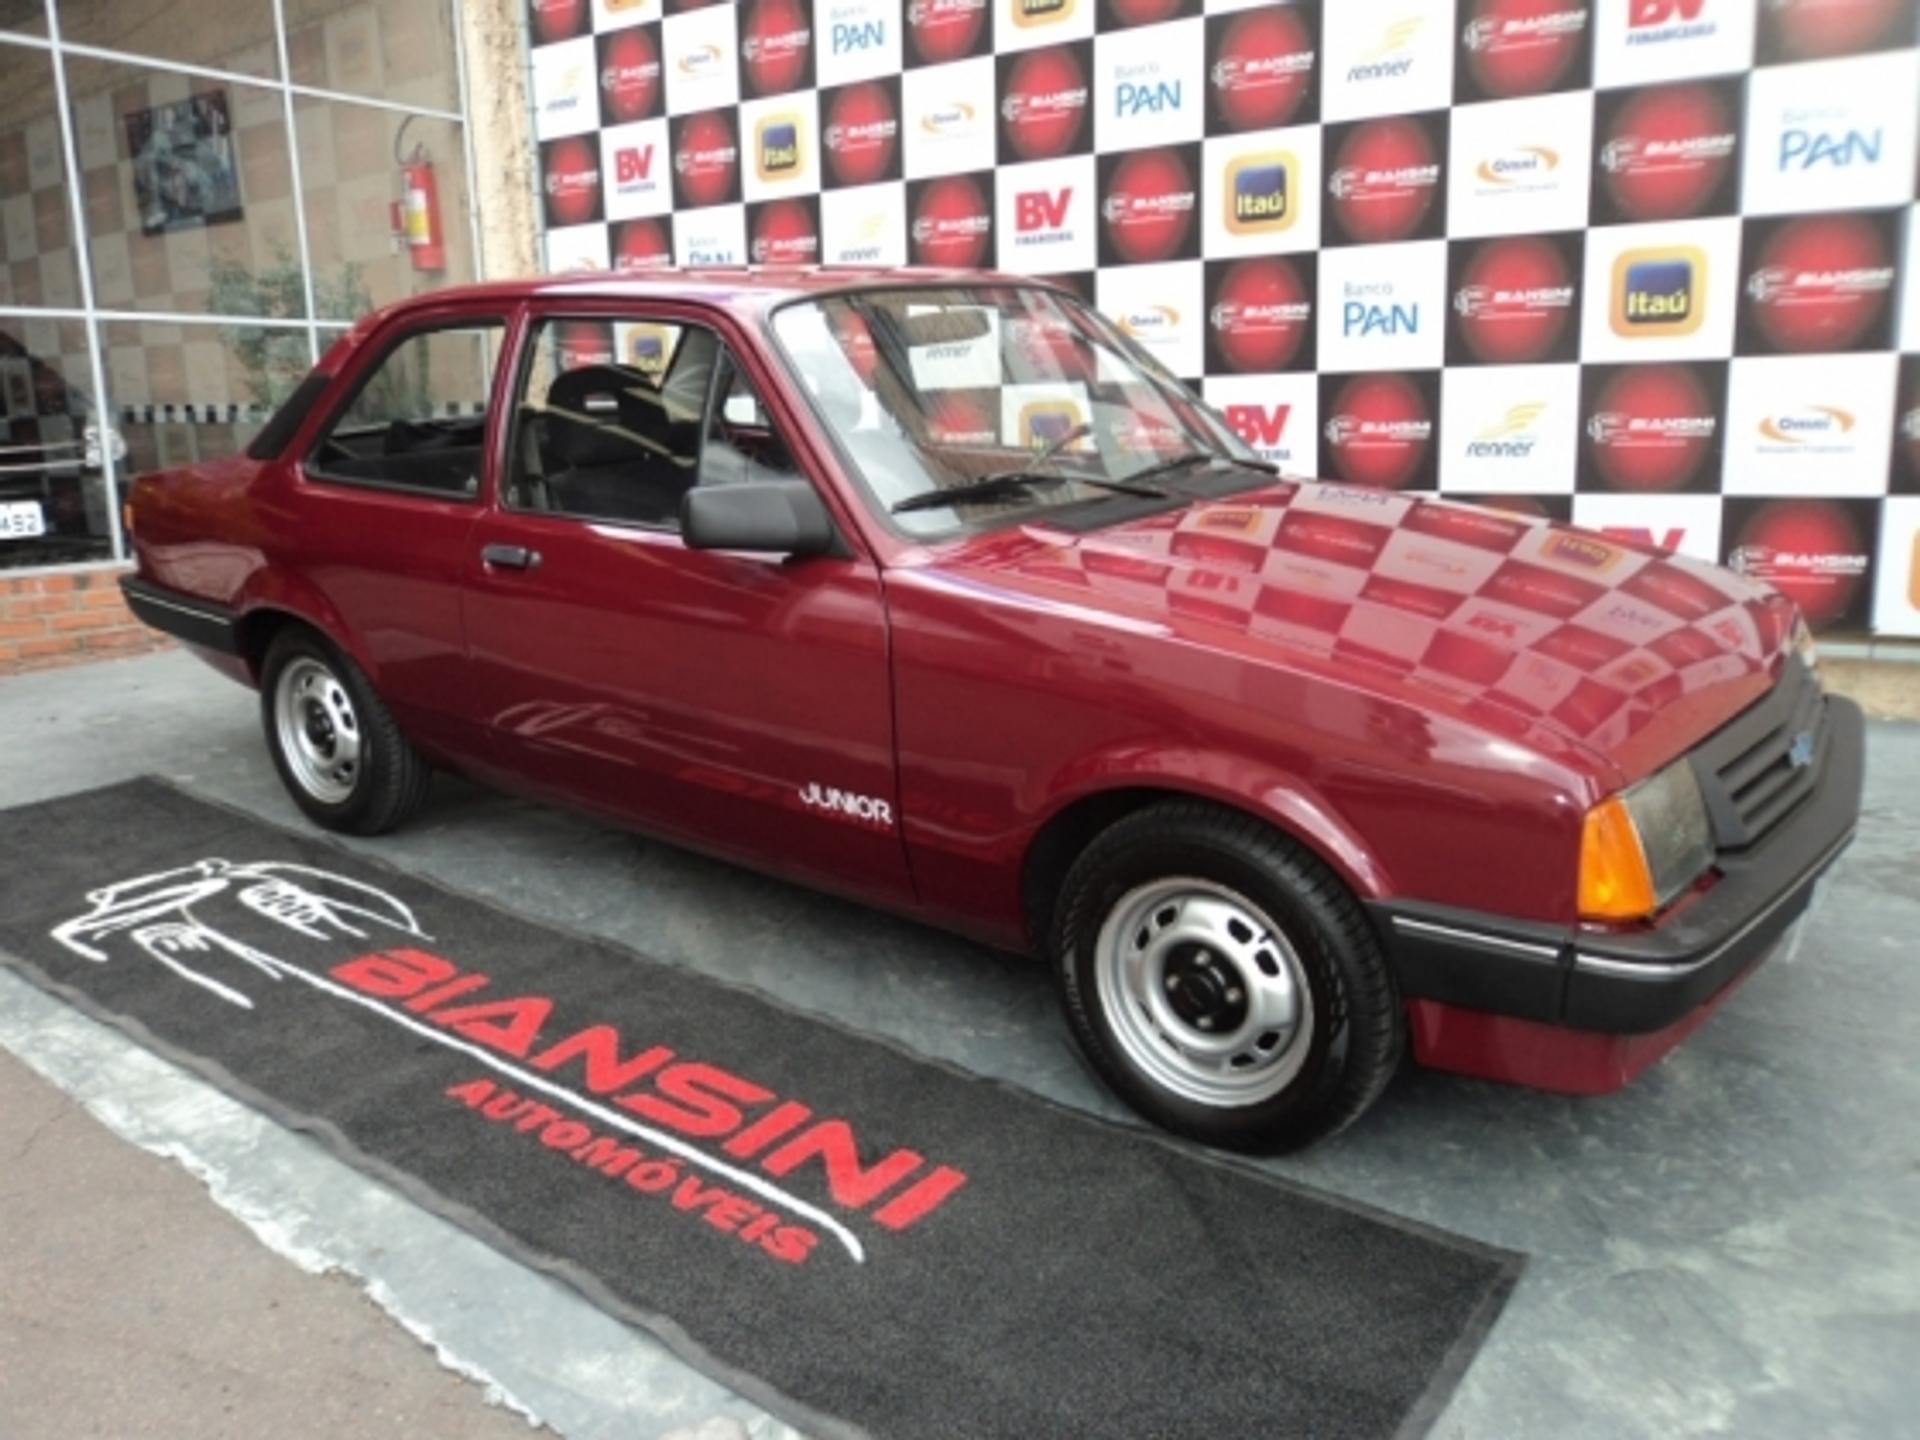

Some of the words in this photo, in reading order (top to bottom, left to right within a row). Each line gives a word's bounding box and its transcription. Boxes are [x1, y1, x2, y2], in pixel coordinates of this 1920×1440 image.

[832, 21, 884, 55] PAN
[1347, 58, 1414, 82] renner
[1116, 80, 1181, 117] PAN
[615, 144, 654, 183] BV
[1779, 127, 1882, 171] PAN
[1015, 187, 1073, 231] BV
[1237, 191, 1284, 215] Itaú
[1344, 281, 1394, 297] Banco
[1627, 289, 1688, 316] Itaú
[1343, 302, 1418, 337] PAN
[1224, 404, 1291, 446] BV
[1465, 440, 1535, 457] renner
[798, 781, 893, 825] JUNIOR
[328, 947, 968, 1231] BIANSINI
[446, 1079, 818, 1265] AUTOMÓVEIS
